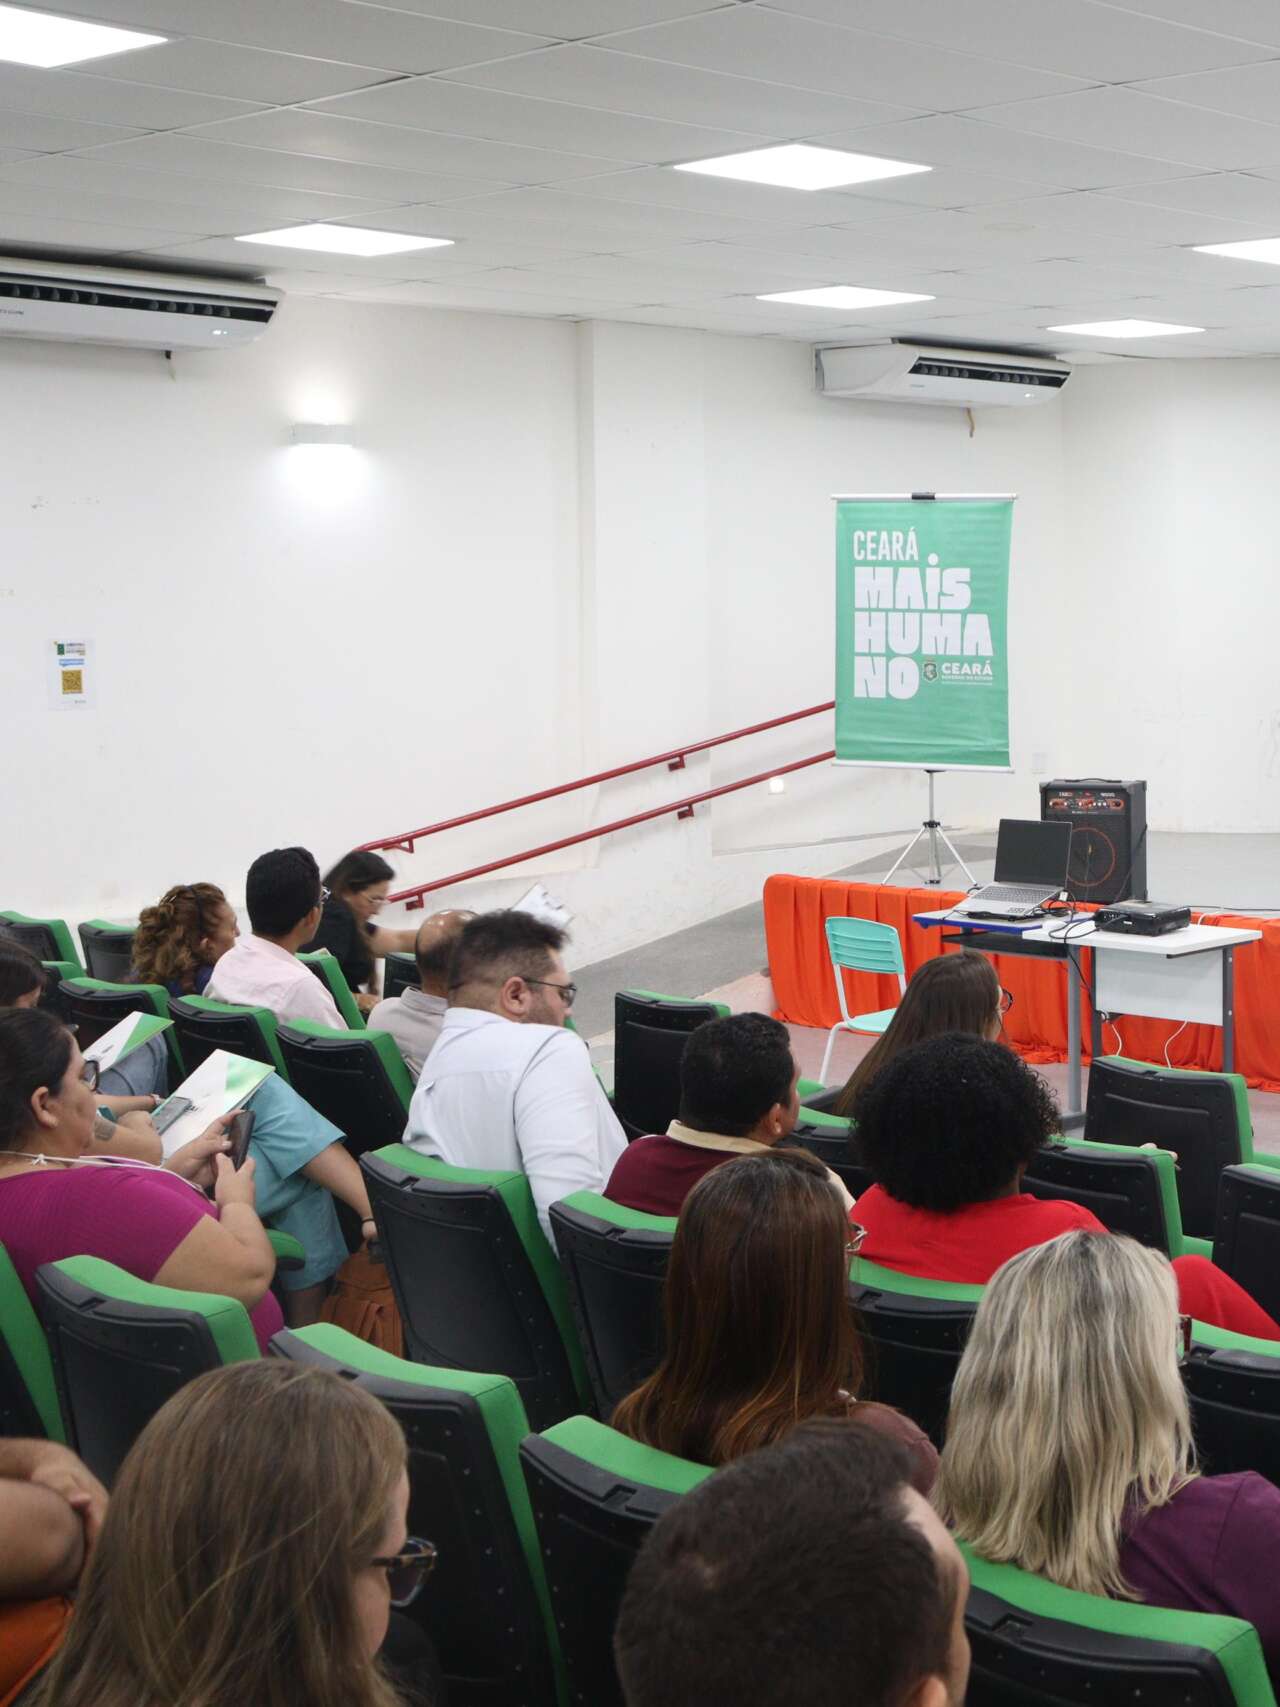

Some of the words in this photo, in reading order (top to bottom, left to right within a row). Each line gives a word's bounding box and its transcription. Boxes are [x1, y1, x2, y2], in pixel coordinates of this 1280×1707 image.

[853, 527, 919, 561] CEARÁ
[854, 611, 994, 656] HUMA
[854, 655, 920, 700] NO
[941, 660, 993, 676] CEARÁ
